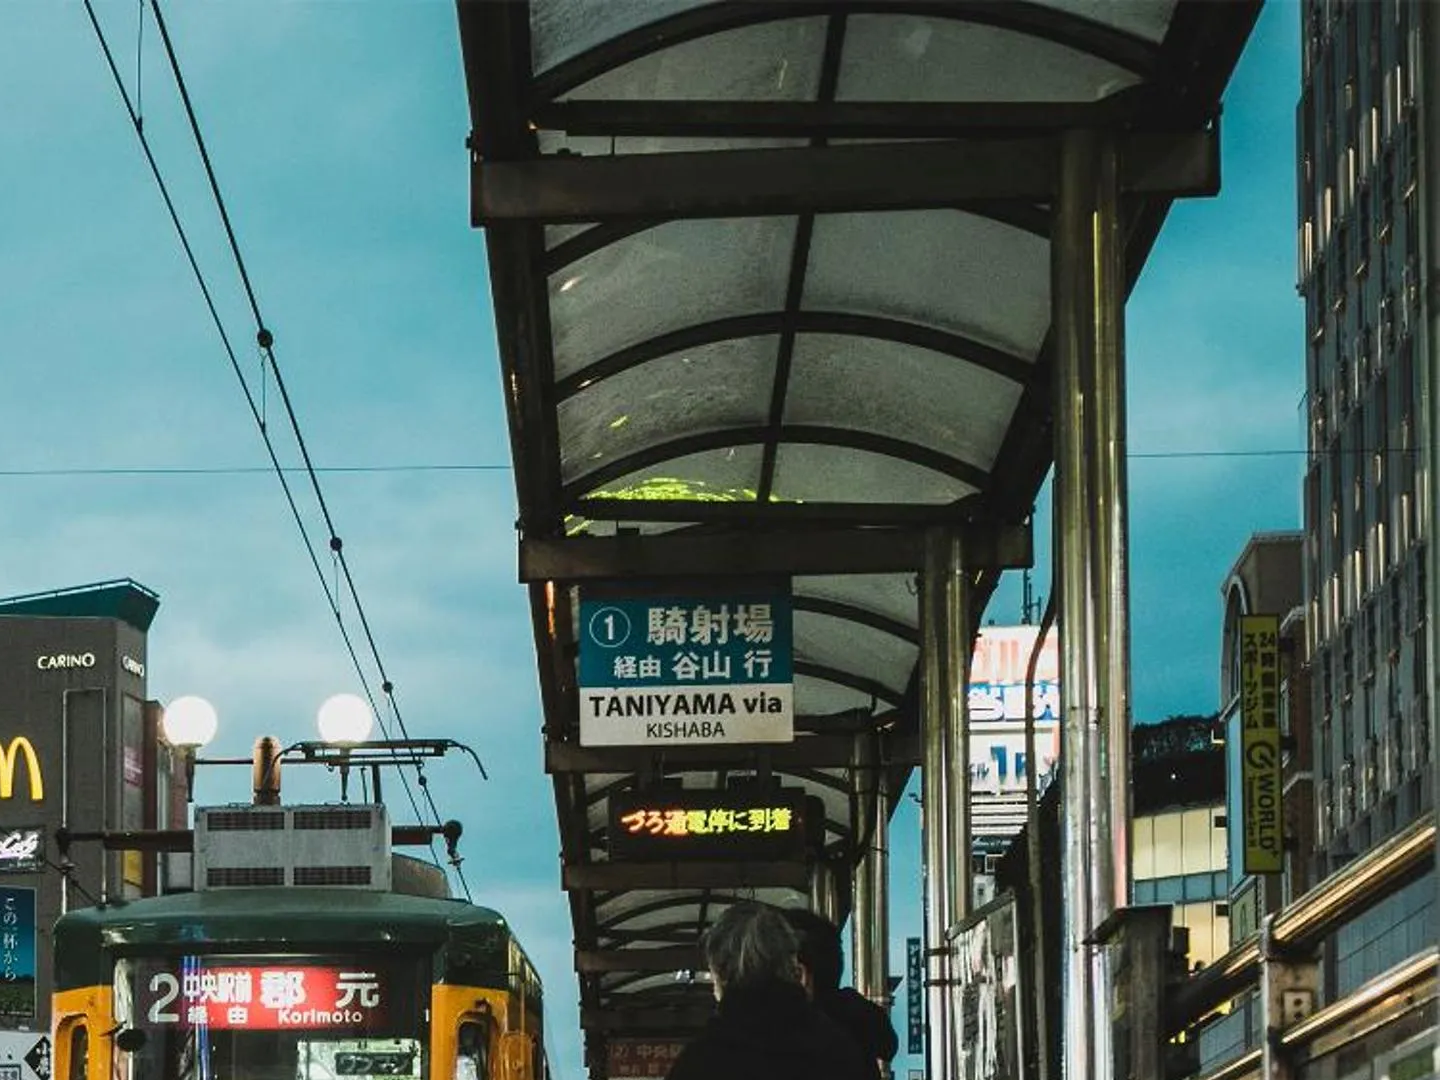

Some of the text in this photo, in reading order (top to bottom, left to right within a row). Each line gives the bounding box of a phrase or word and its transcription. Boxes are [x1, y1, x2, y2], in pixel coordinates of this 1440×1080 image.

[647, 603, 774, 645] 騎射場
[37, 652, 96, 670] CARINO
[613, 650, 773, 680] 経由 谷山 行
[589, 691, 783, 718] TANIYAMA via
[646, 721, 726, 739] KISHABA
[148, 972, 180, 1023] 2
[277, 1008, 363, 1024] Korimoto
